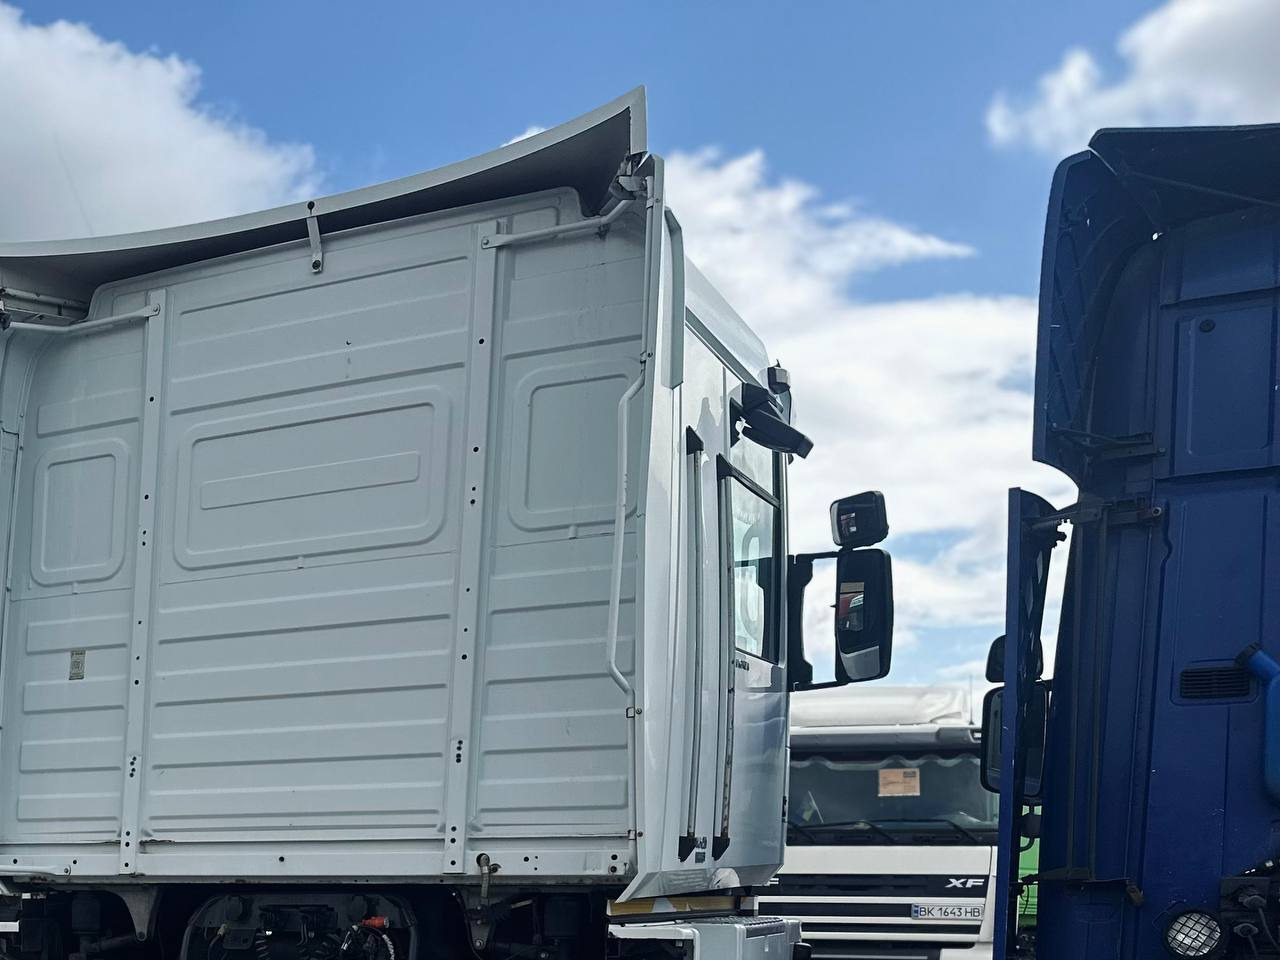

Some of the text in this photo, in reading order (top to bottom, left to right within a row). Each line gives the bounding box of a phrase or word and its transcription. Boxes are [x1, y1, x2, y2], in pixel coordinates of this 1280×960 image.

[944, 878, 985, 888] XF
[919, 907, 981, 918] BK 1643 HB
